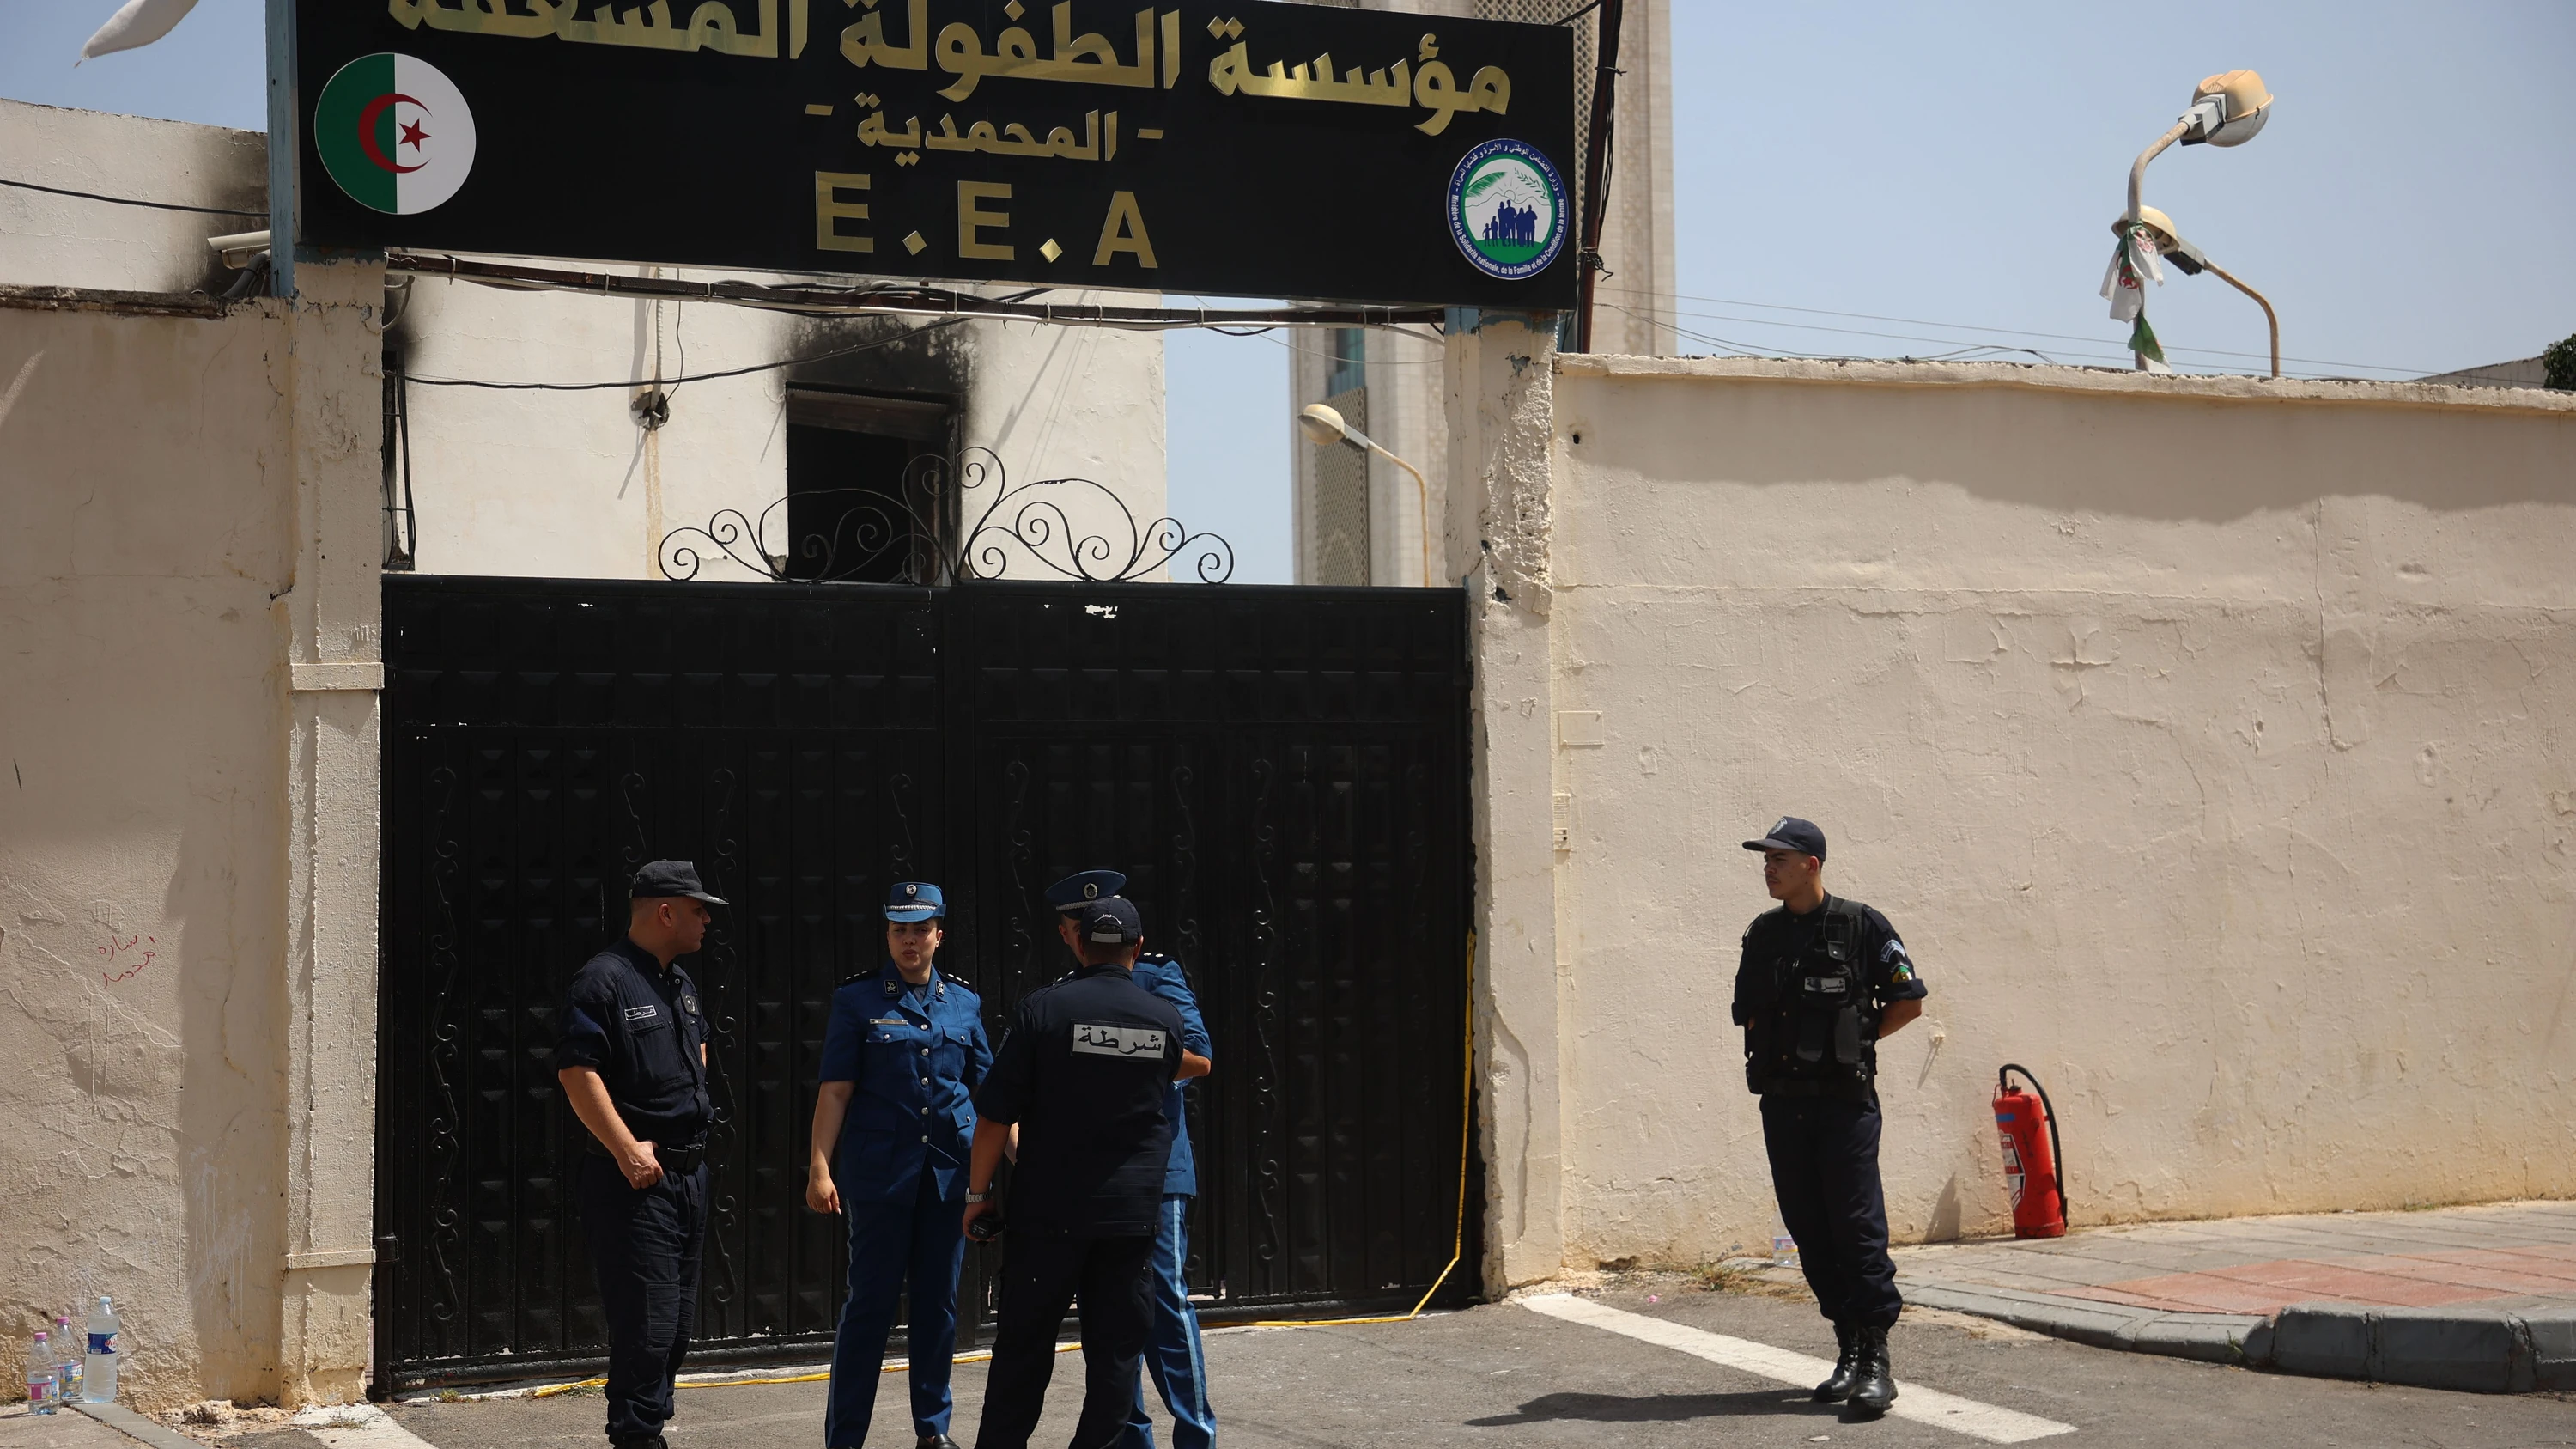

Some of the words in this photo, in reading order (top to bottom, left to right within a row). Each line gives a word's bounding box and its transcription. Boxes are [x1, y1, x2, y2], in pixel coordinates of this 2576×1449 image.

[840, 0, 1181, 102] الطفولة
[1206, 16, 1511, 137] مؤسسة
[854, 92, 1118, 167] المحمدية
[1463, 152, 1479, 169] قضايا
[1509, 143, 1529, 155] الوطني
[1528, 153, 1551, 173] التضامن
[1454, 167, 1466, 186] المرأة
[1548, 172, 1559, 191] وزارة
[1454, 221, 1461, 229] de
[1459, 234, 1479, 259] Solidarité
[1500, 265, 1507, 274] de
[1508, 266, 1513, 275] la
[1513, 264, 1531, 275] Famille
[1535, 258, 1543, 266] de
[1544, 232, 1562, 257] Condition
[1557, 198, 1565, 218] femme
[1078, 1026, 1162, 1056] شرطة
